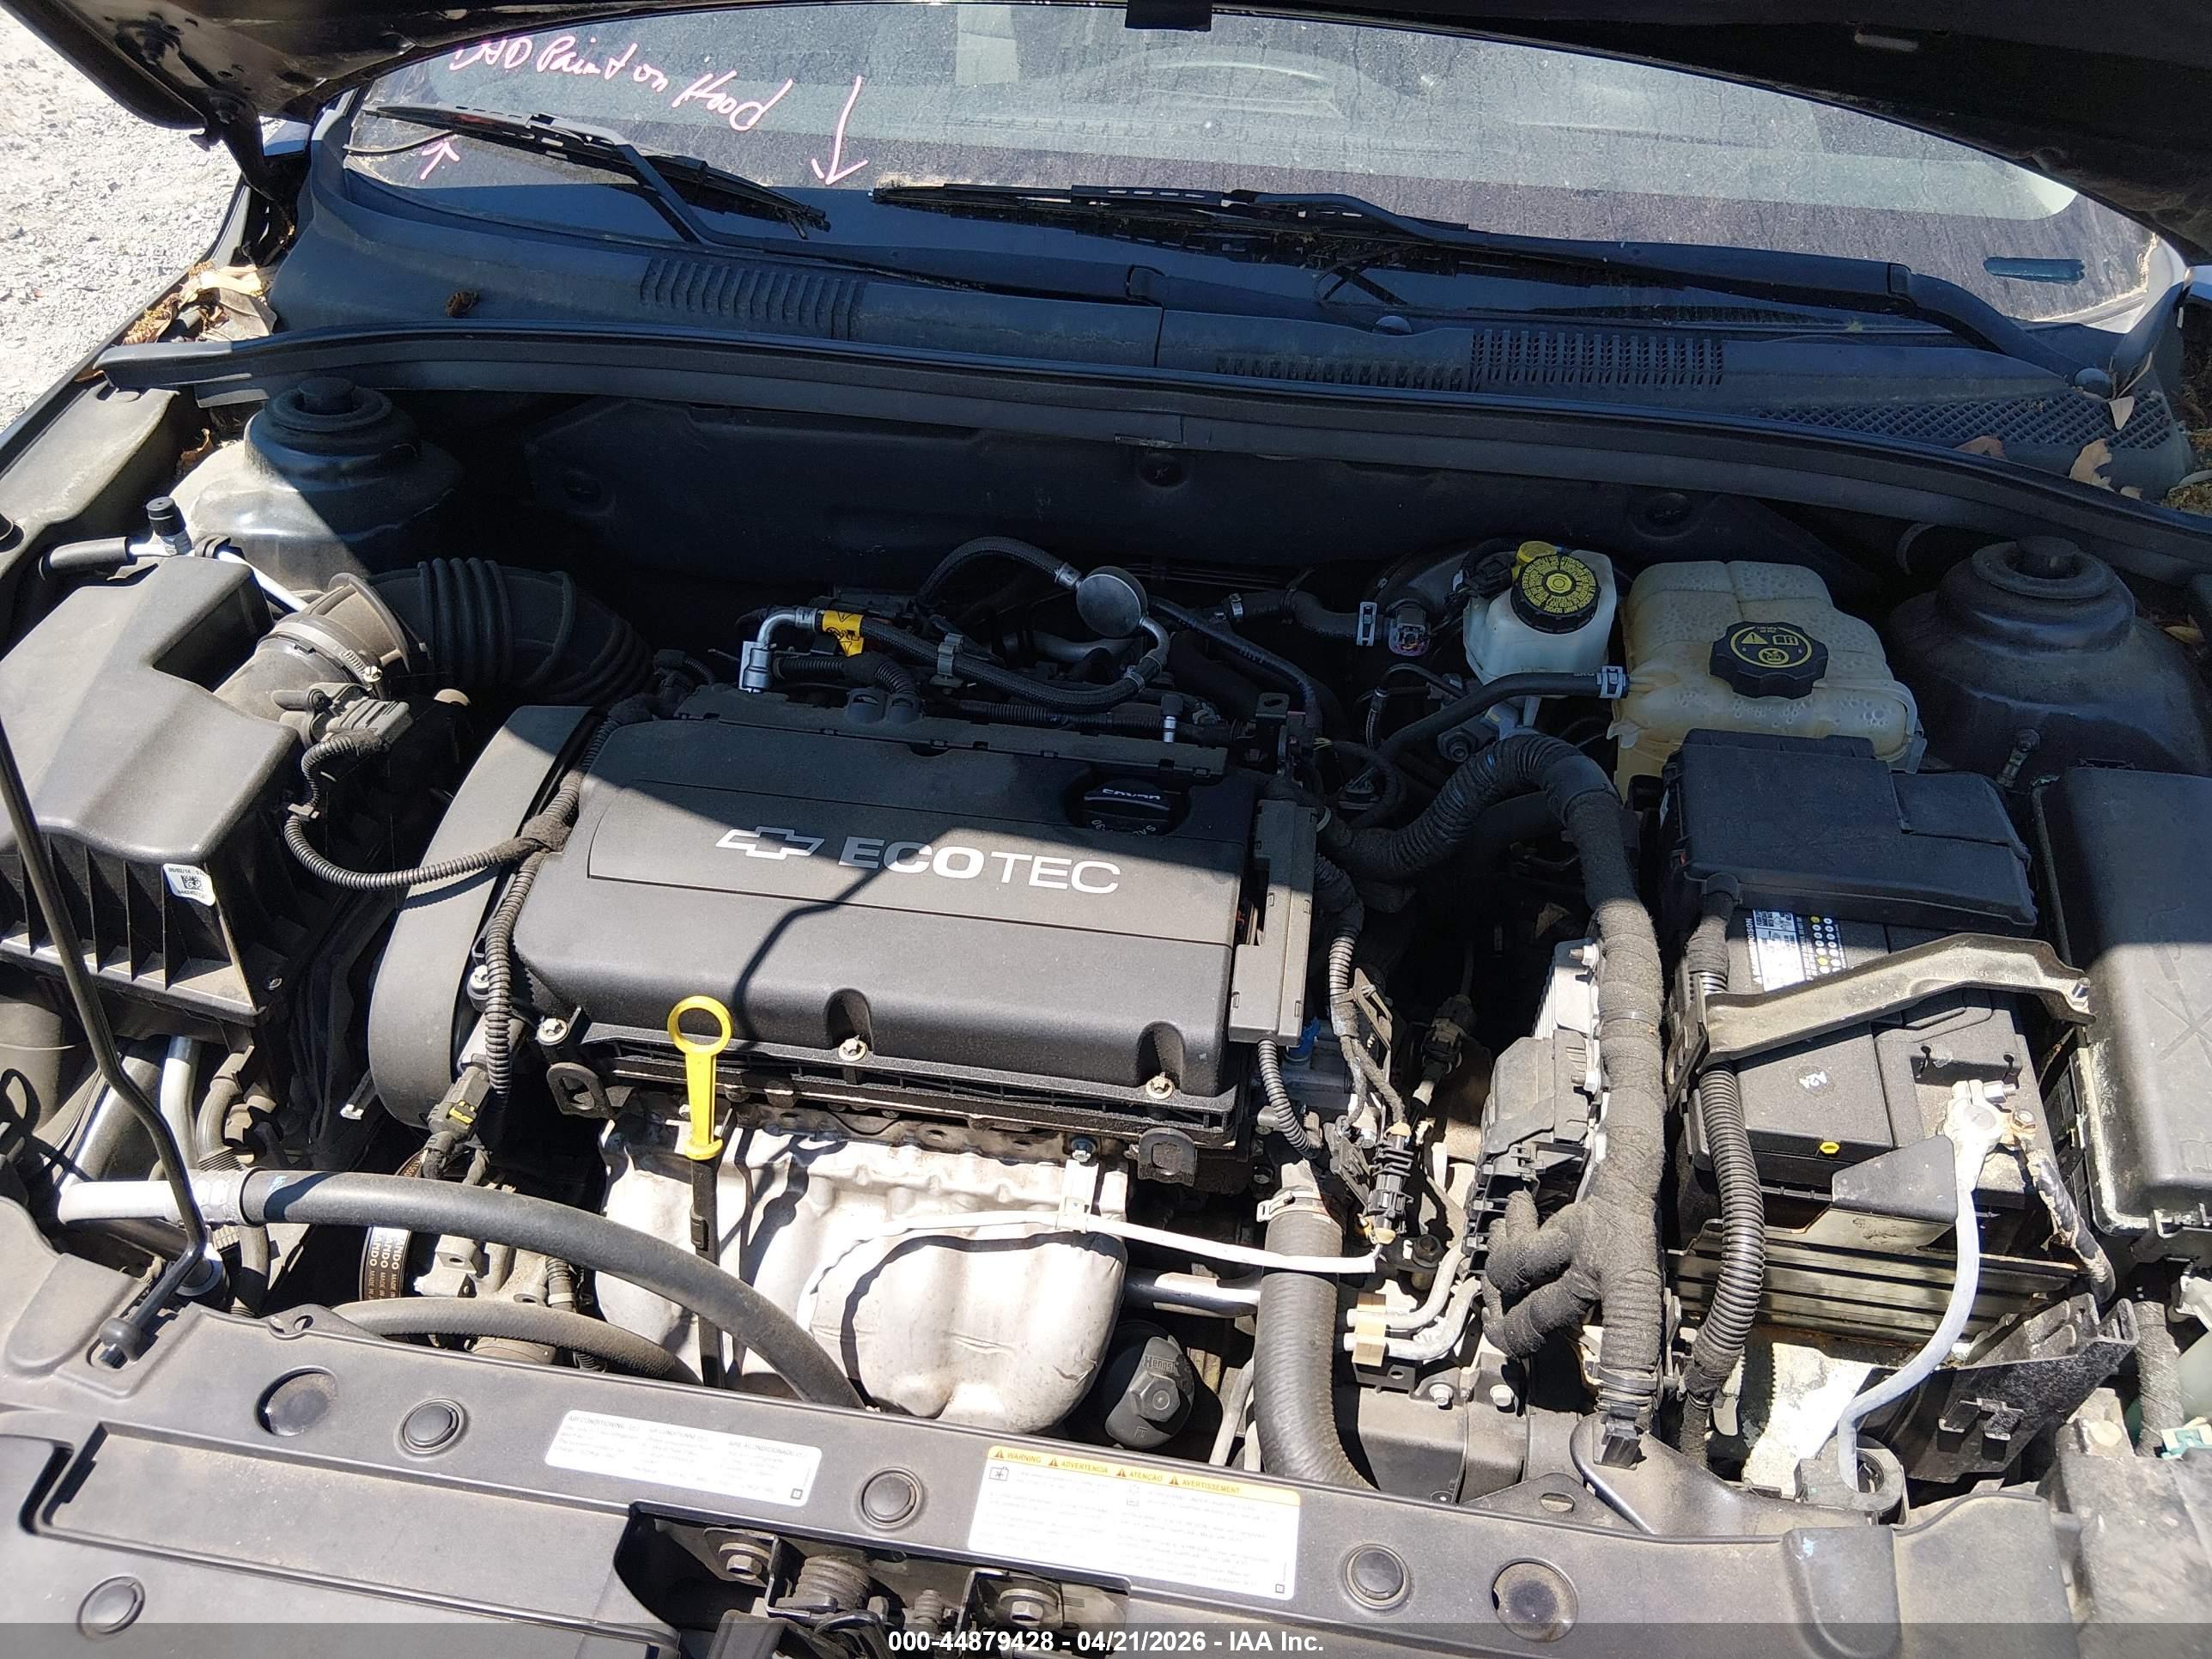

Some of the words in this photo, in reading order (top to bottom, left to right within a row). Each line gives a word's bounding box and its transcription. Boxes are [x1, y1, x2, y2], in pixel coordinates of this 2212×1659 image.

[633, 64, 670, 94] on
[672, 70, 793, 131] Hood
[837, 836, 1121, 894] ECOTEC
[369, 1234, 382, 1267] ANDO
[380, 1236, 393, 1268] ANDO
[391, 1235, 405, 1270] ANDO
[1006, 1451, 1042, 1464] WARNING
[1060, 1460, 1109, 1474] ADVERTENCIA
[1182, 1479, 1241, 1494] AVERTISSEMENT
